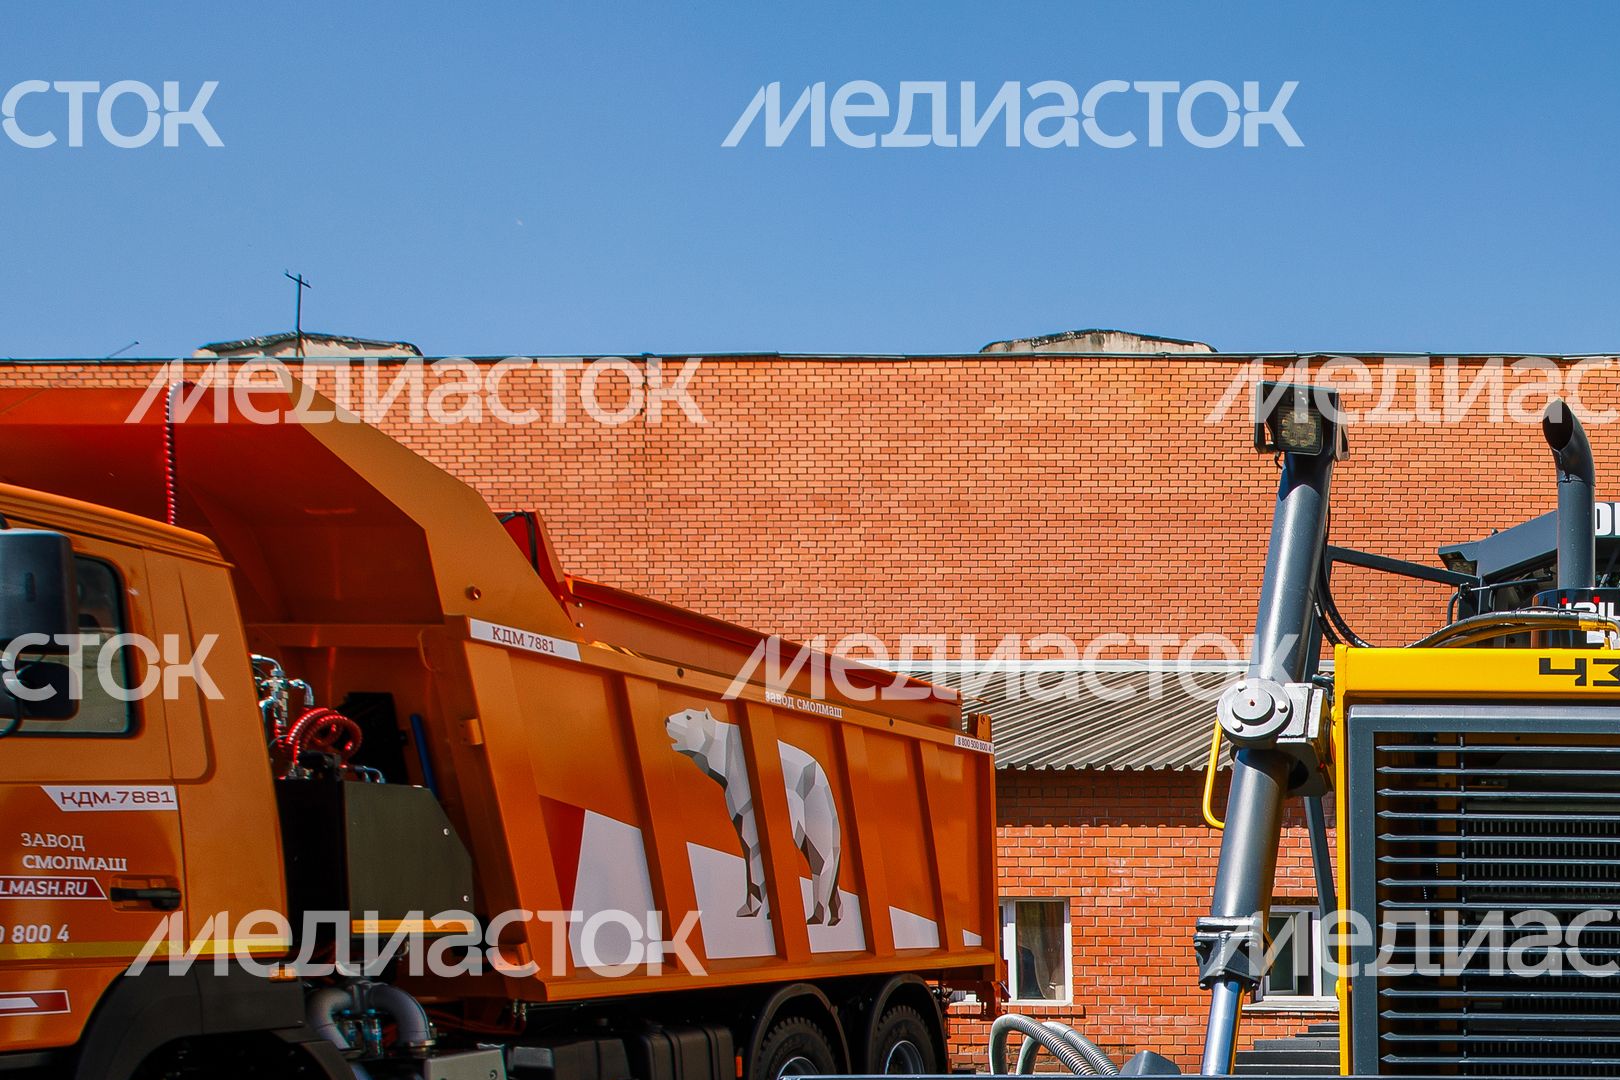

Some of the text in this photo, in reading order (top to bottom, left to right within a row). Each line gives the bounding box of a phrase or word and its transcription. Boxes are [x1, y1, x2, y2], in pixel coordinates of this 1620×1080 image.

[491, 625, 555, 653] КДМ 7881
[60, 791, 175, 808] КДМ-7881
[21, 832, 85, 851] ЗАВОД
[22, 855, 128, 872] СМОЛМАШ
[12, 924, 52, 943] 800
[57, 923, 70, 942] 4
